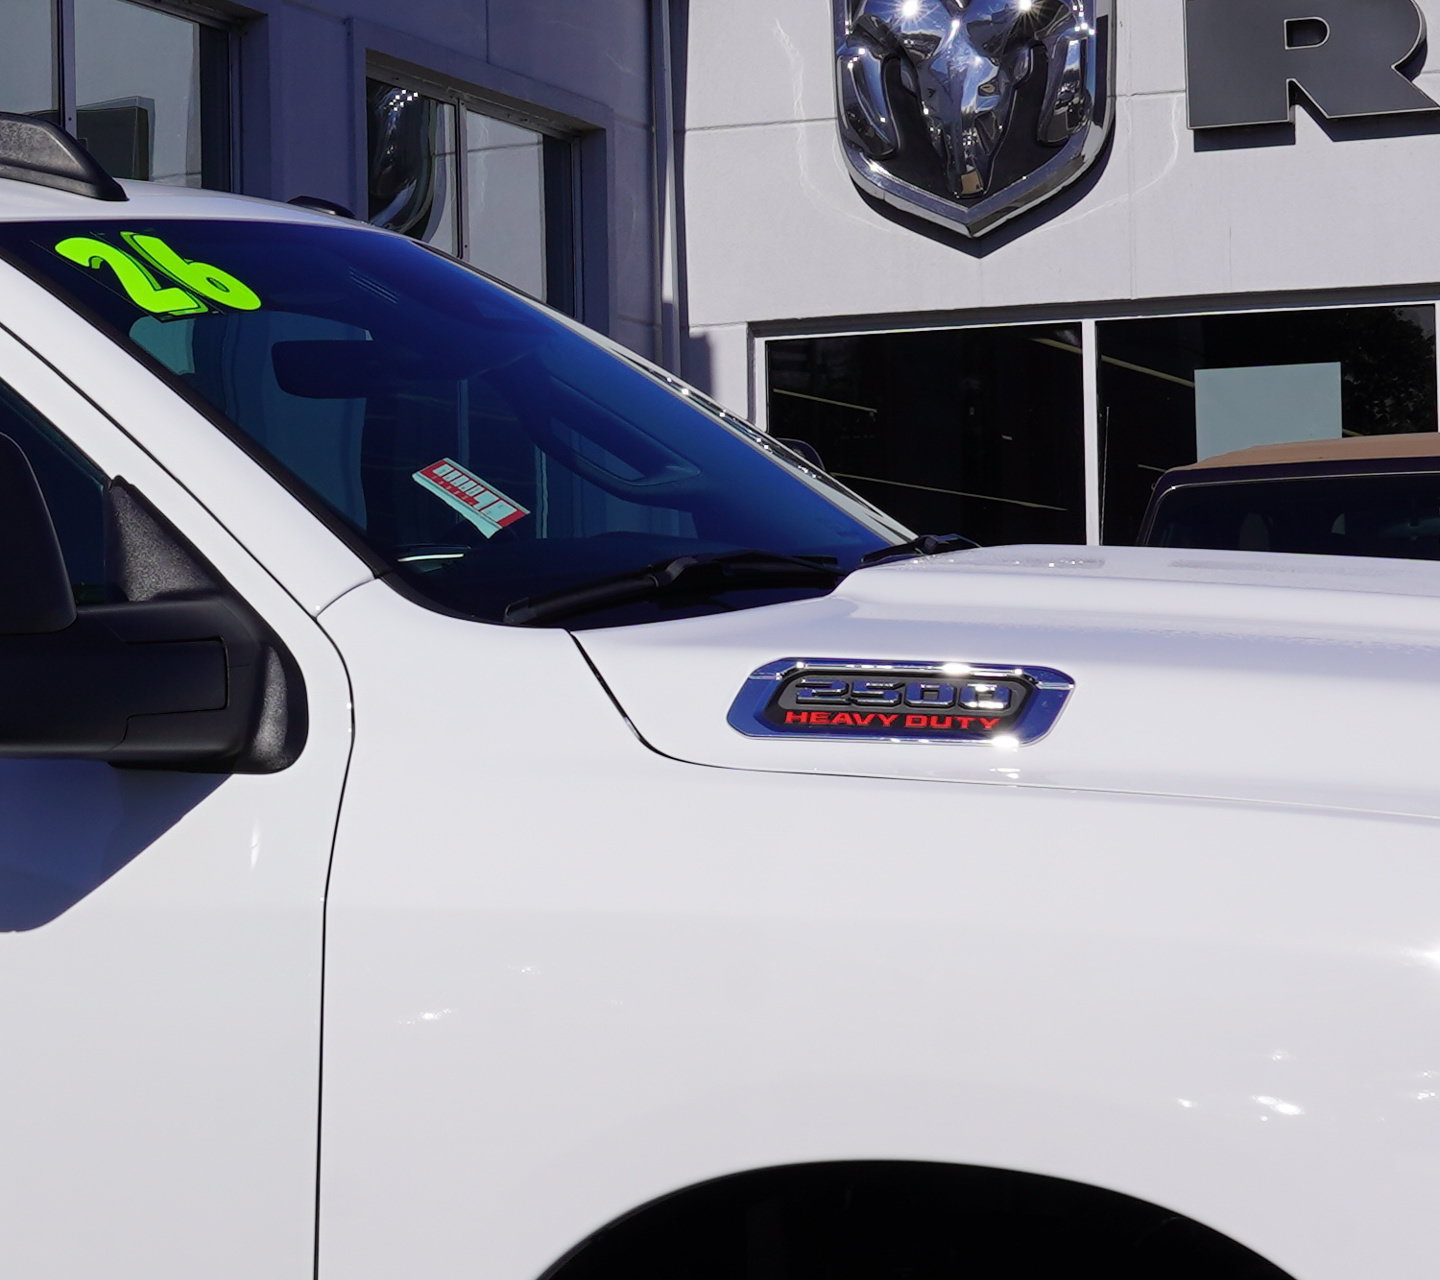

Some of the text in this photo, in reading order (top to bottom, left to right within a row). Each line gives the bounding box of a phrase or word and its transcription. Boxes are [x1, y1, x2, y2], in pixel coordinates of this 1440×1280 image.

[55, 231, 261, 316] 26
[795, 678, 1013, 709] 2500
[785, 710, 1001, 730] HEAVY DUTY
